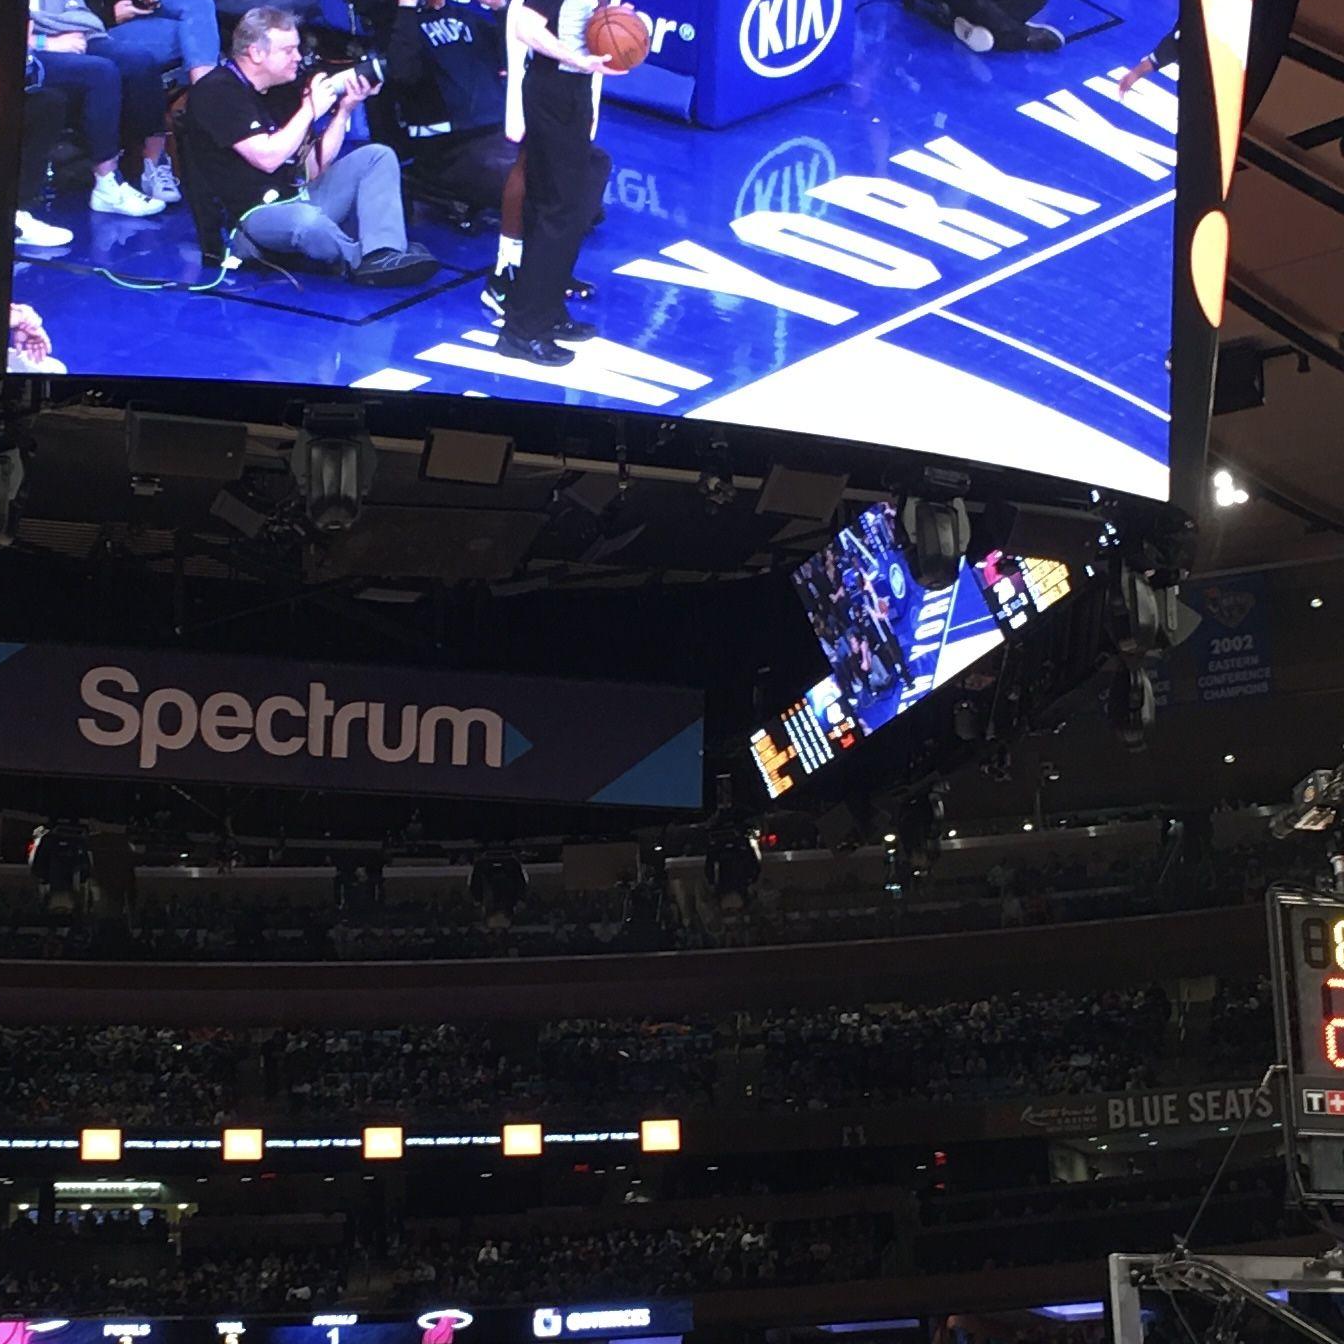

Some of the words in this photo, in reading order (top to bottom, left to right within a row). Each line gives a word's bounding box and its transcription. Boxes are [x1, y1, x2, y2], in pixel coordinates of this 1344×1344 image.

[613, 137, 1102, 326] YORK
[1210, 634, 1253, 654] 2002
[1207, 655, 1259, 672] EASTERN
[1197, 666, 1272, 689] CONFERENCE
[1202, 682, 1269, 702] CHAMPIONS
[78, 665, 504, 769] Spectrum
[1107, 1094, 1179, 1129] BLUE
[1188, 1087, 1274, 1122] SEATS
[327, 1327, 339, 1344] 1
